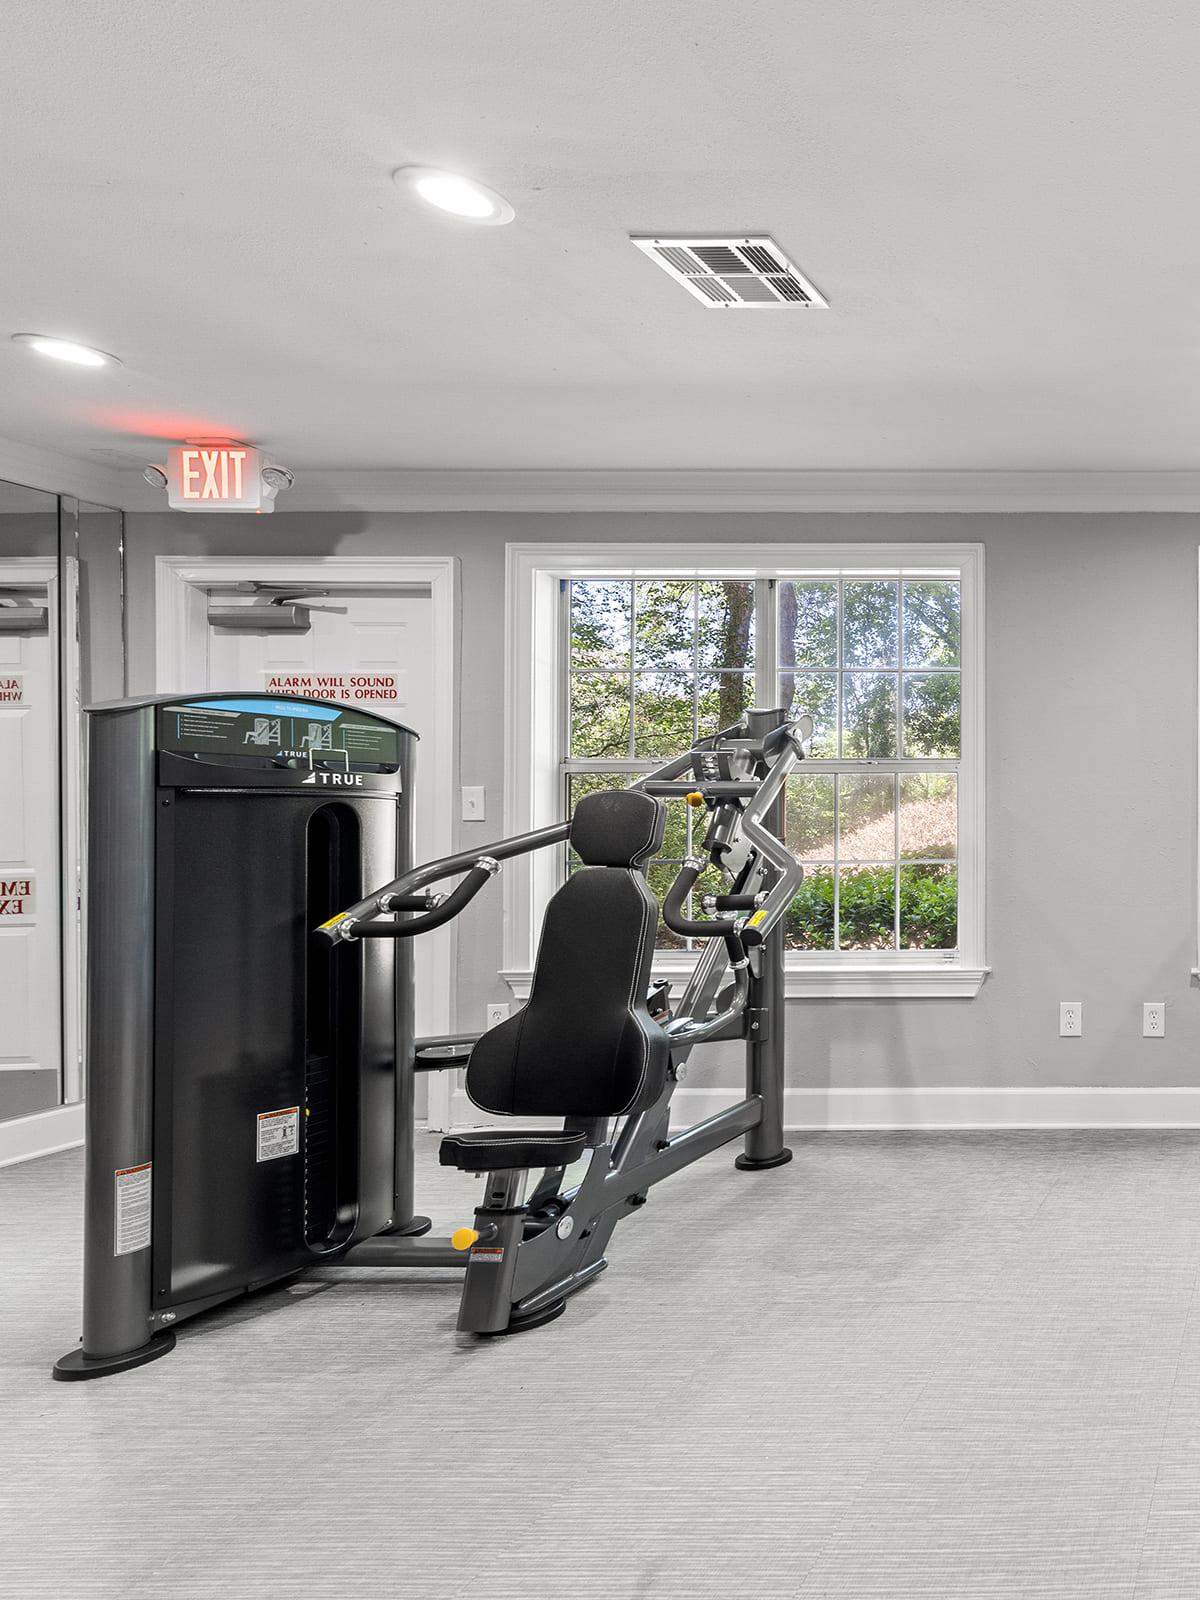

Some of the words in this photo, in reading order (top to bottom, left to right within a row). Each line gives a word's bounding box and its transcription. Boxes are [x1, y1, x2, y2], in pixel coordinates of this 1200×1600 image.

[182, 450, 246, 498] EXIT
[269, 678, 311, 687] ALARM
[317, 678, 345, 687] WILL
[350, 677, 394, 687] SOUND
[303, 689, 336, 699] DOOR
[341, 689, 350, 699] IS
[355, 689, 398, 699] OPENED
[284, 750, 308, 758] TRUE
[319, 772, 363, 786] TRUE
